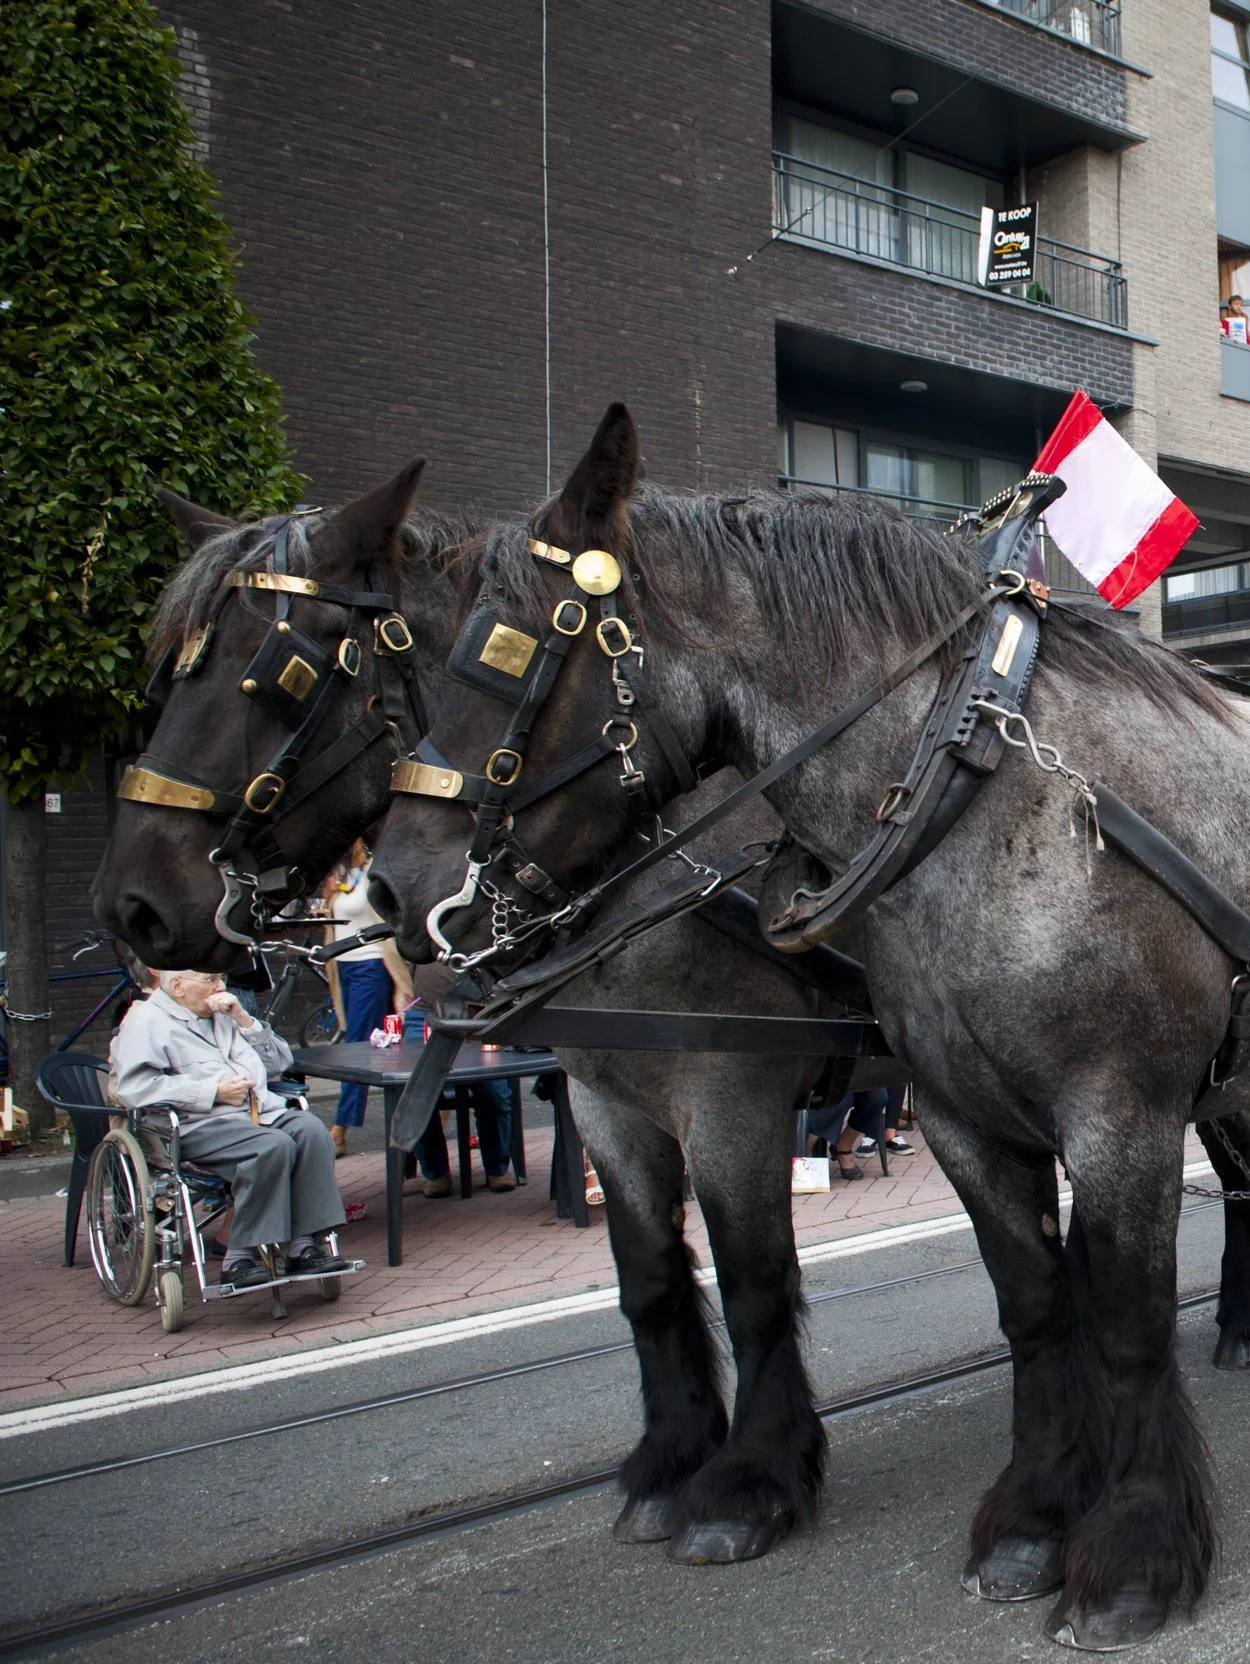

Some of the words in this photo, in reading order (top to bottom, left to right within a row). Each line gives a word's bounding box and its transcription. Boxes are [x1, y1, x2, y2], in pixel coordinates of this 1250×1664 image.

[998, 212, 1007, 222] TE
[1008, 207, 1031, 221] KOOP
[989, 272, 998, 280] 03
[1012, 269, 1021, 277] 04
[1022, 268, 1030, 276] 04
